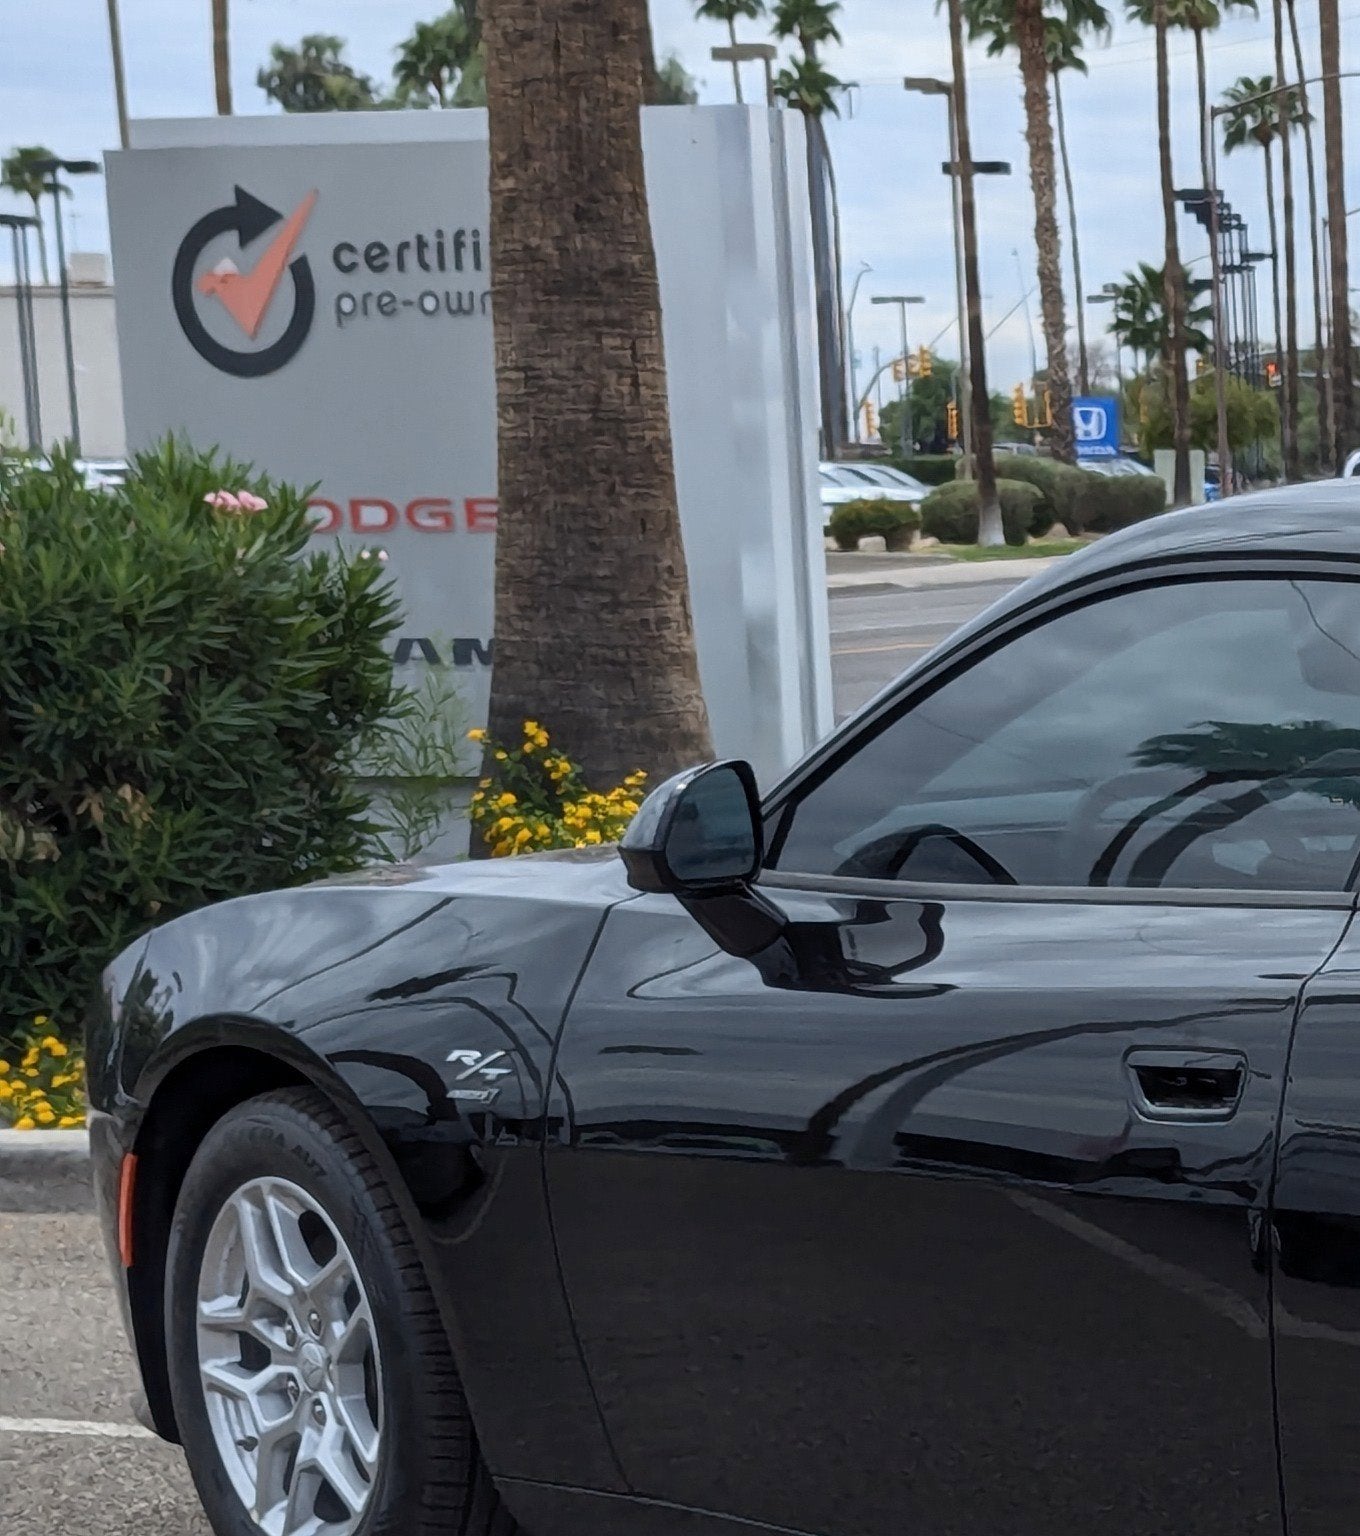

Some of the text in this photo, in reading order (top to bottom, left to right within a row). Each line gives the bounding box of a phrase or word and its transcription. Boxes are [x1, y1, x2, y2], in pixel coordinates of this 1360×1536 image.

[333, 229, 483, 273] certifi
[335, 290, 491, 328] pre-own
[304, 497, 498, 533] ODGE
[393, 637, 495, 665] AM
[445, 1049, 513, 1080] R/T
